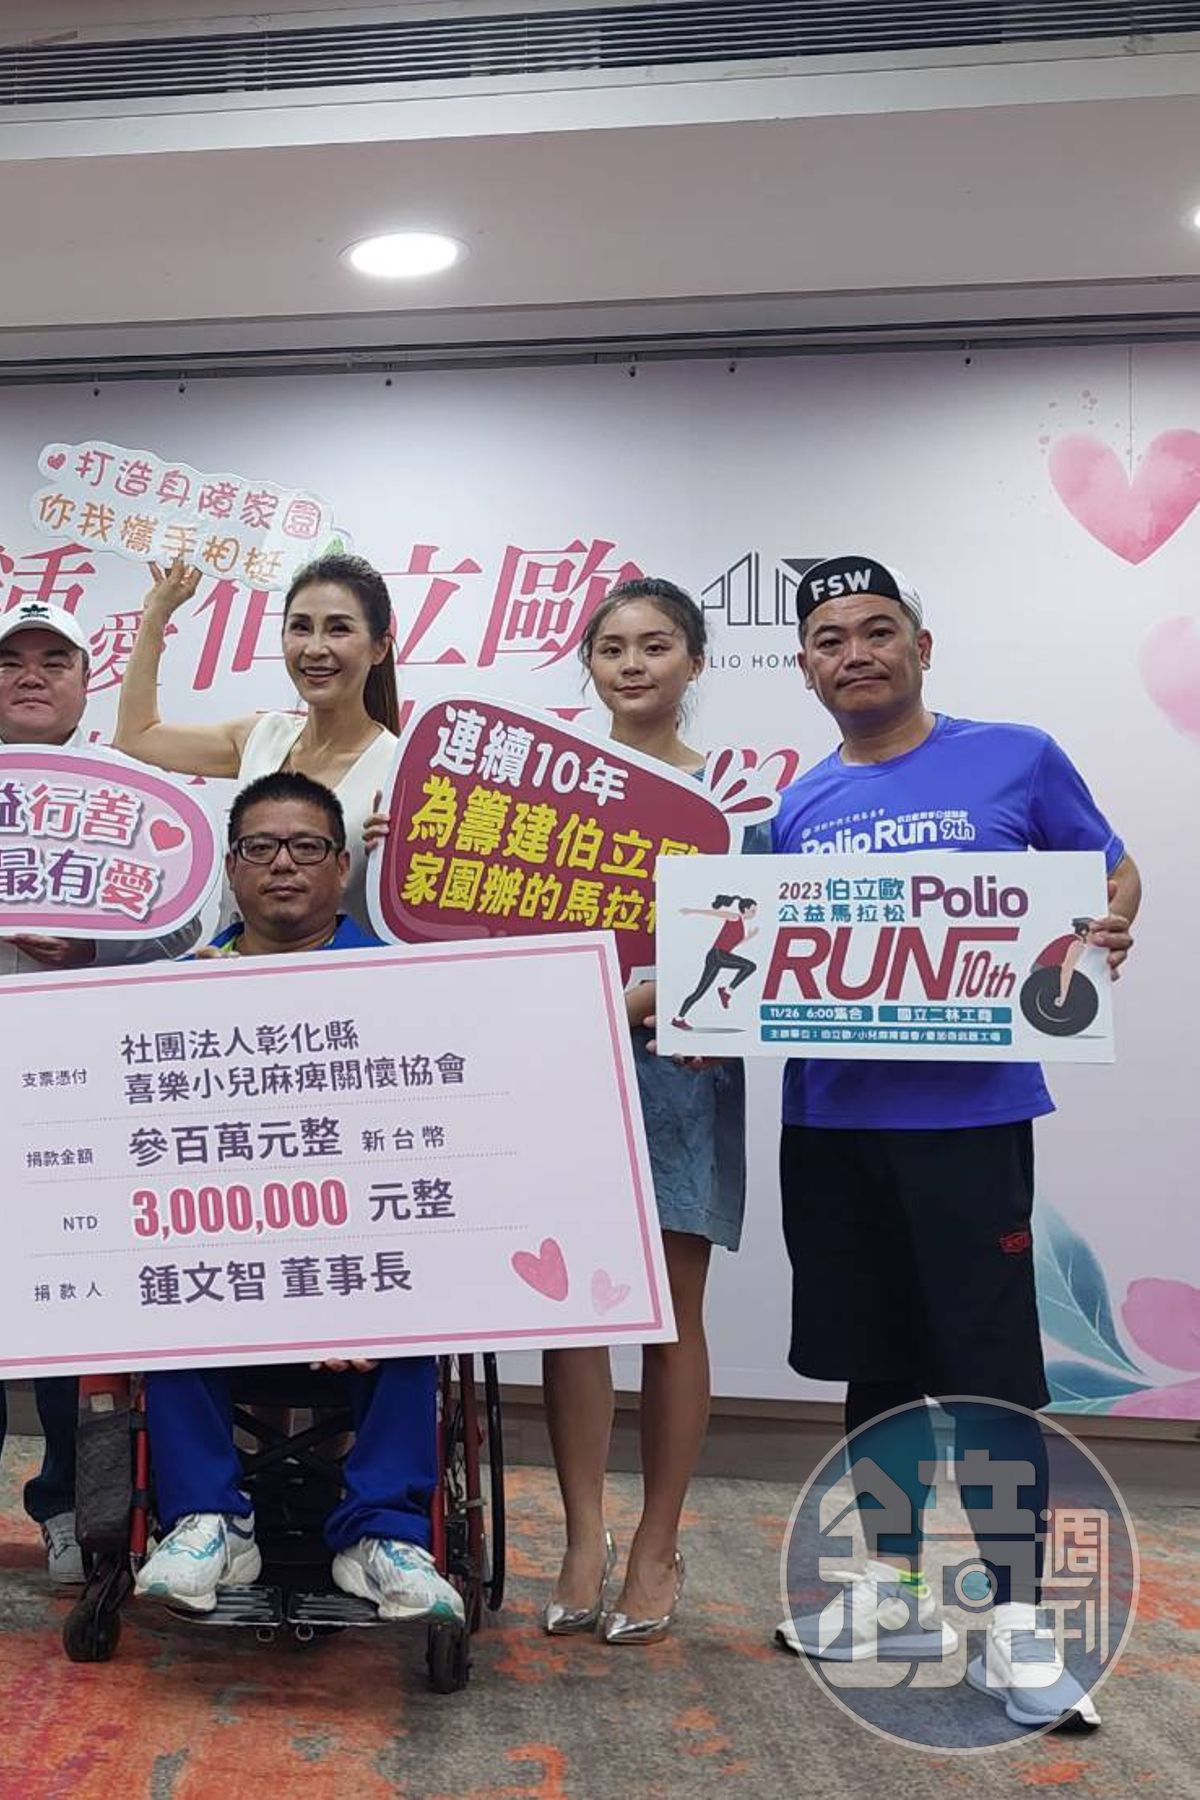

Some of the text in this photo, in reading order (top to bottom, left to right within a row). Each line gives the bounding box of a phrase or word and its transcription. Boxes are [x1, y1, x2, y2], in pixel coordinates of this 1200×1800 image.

[74, 449, 322, 540] 打造身障家園
[809, 567, 872, 602] FSW
[710, 654, 797, 669] LIO HOM
[429, 704, 630, 808] 連續10年
[406, 773, 698, 882] 為籌建伯立
[874, 818, 938, 851] Run
[940, 818, 976, 841] 9th
[778, 903, 906, 923] 公益馬拉松
[910, 875, 1029, 919] Polio
[761, 926, 1021, 1001] RUN
[120, 1019, 360, 1065] 社團法人彰化縣
[123, 1050, 468, 1106] 喜樂小兒麻痺關懷協會
[25, 1147, 95, 1169] 捐款金額
[127, 1116, 448, 1168] 參百萬元整 新台幣
[62, 1215, 99, 1232] NTD
[131, 1177, 456, 1241] 3,000,000 元整
[33, 1282, 102, 1303] 捐款人
[138, 1250, 413, 1307] 鍾文智 董事長
